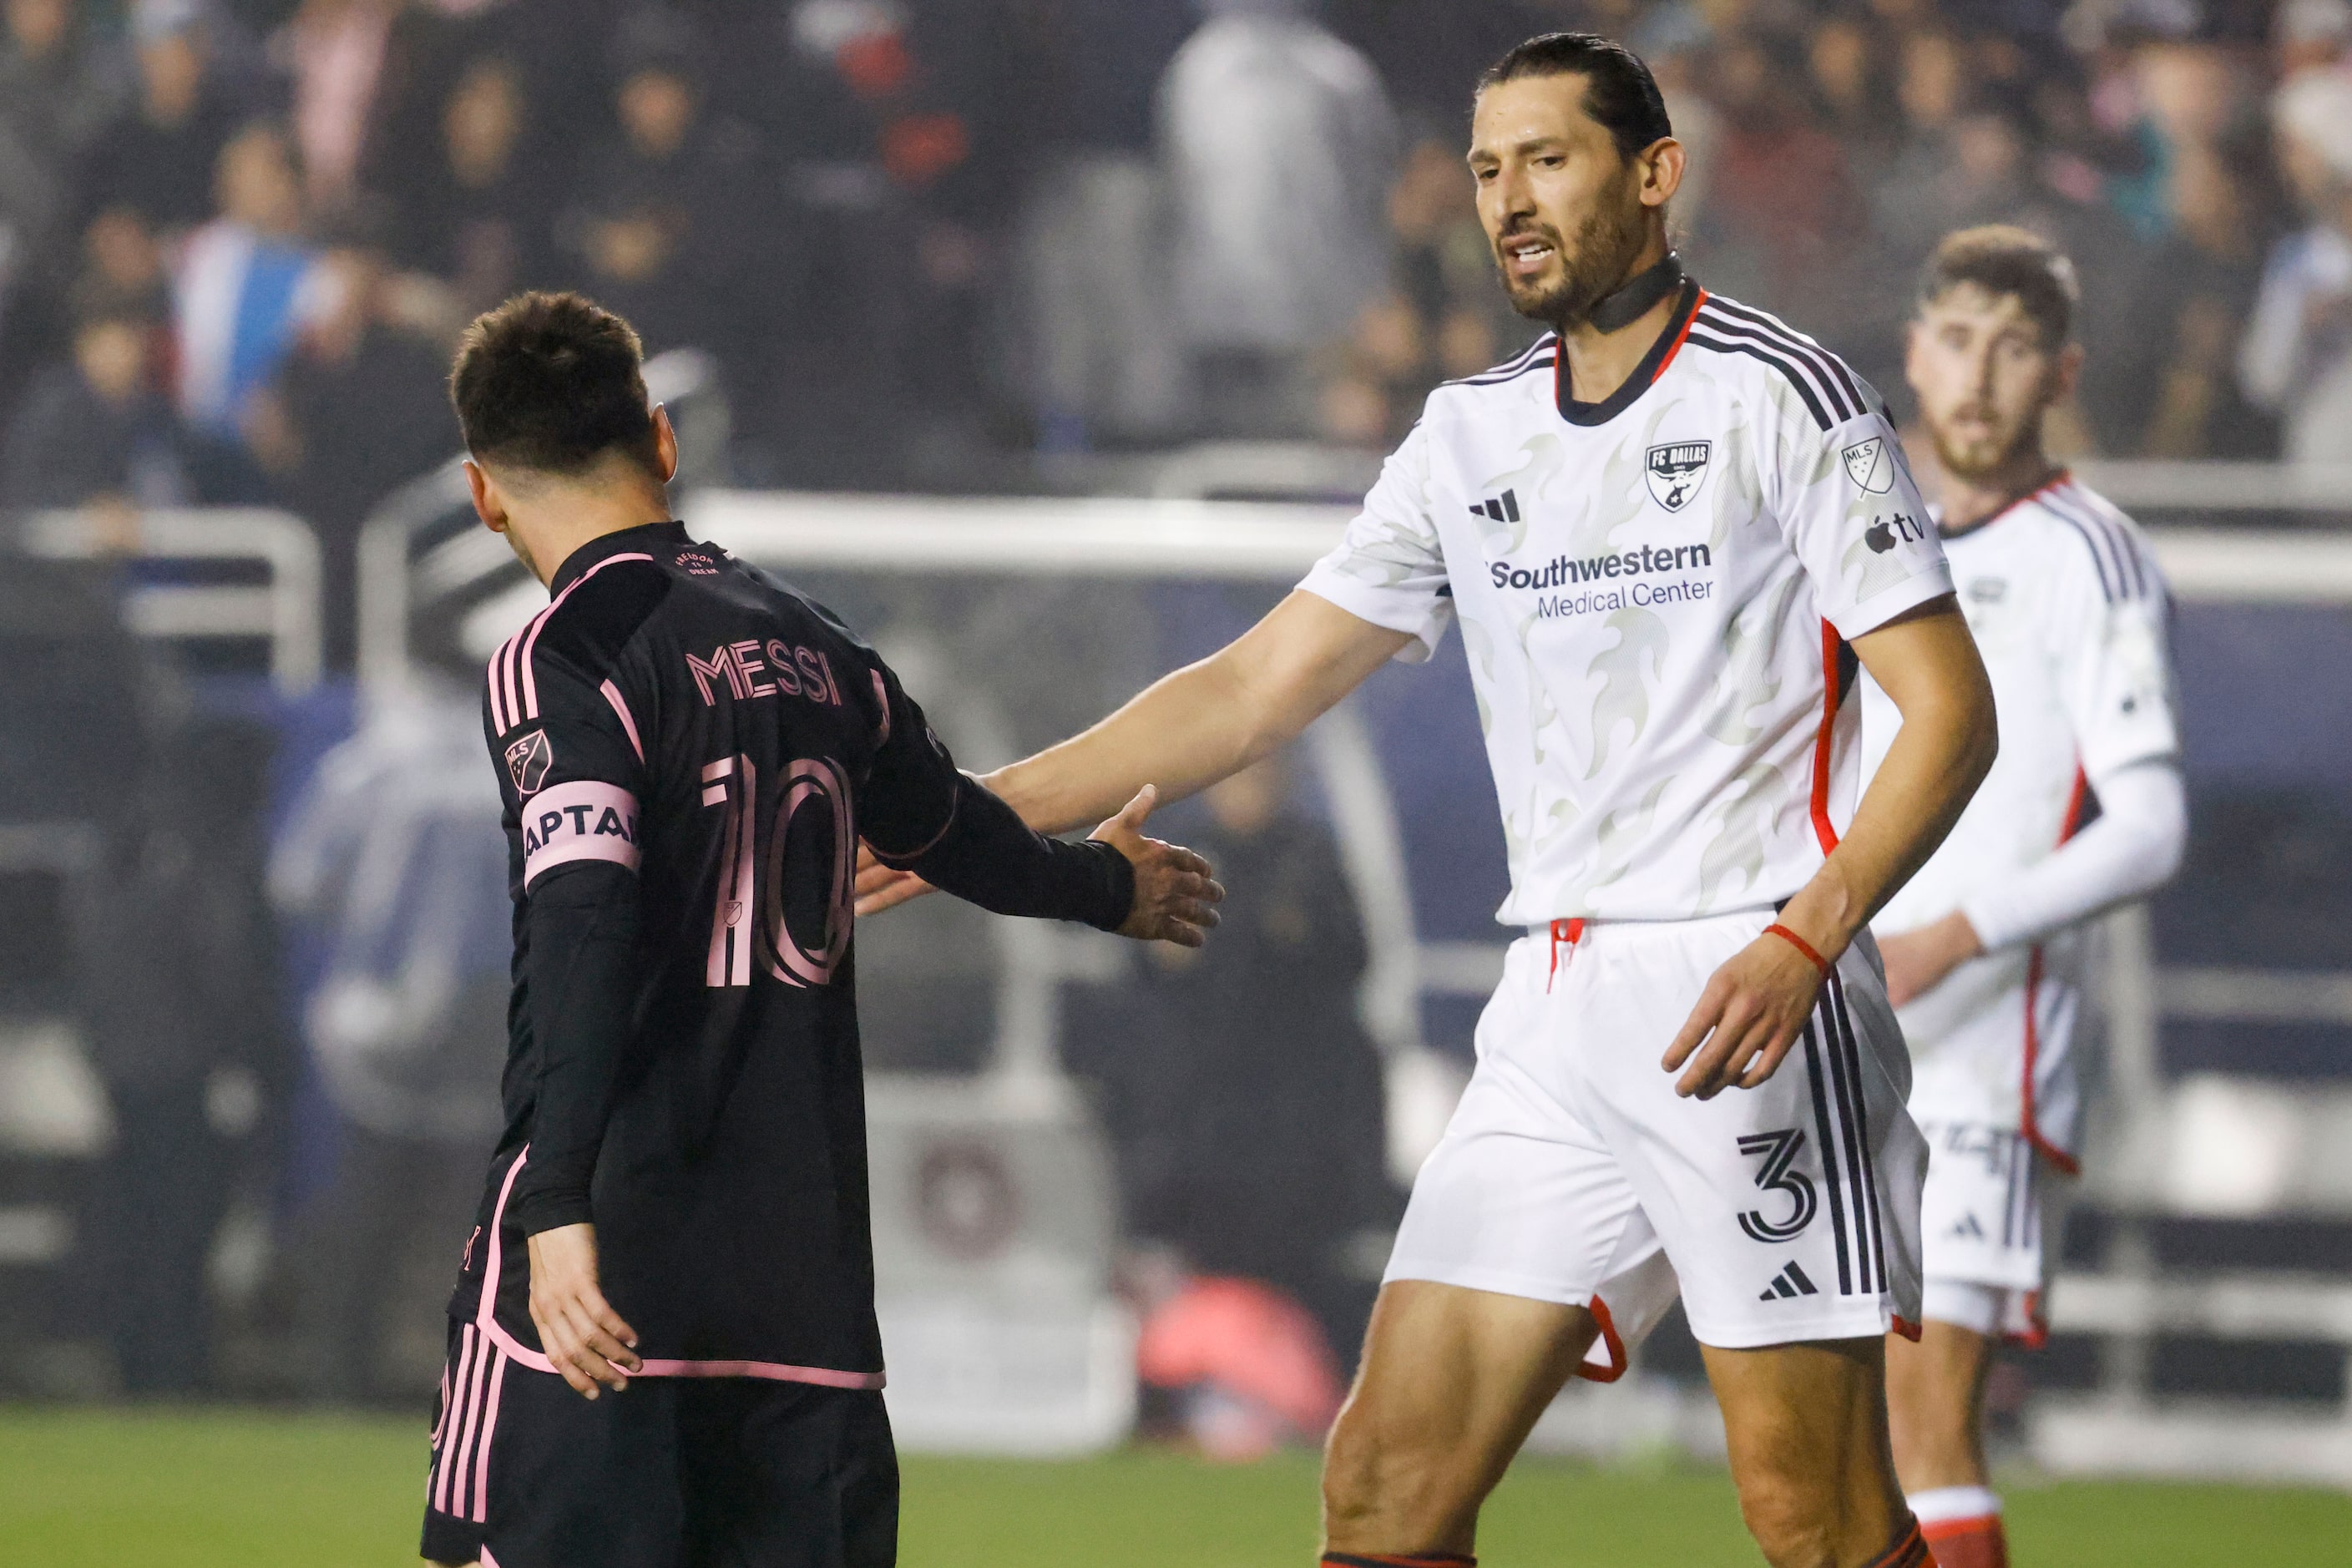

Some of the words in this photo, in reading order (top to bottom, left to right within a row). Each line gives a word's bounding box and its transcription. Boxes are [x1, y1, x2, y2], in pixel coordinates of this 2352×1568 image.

[1652, 450, 1667, 468] FC
[1670, 446, 1707, 464] DALLAS
[1846, 444, 1873, 463] MLS
[1491, 543, 1711, 589] Southwestern
[1538, 586, 1627, 619] Medical
[1632, 579, 1713, 606] Center
[685, 639, 842, 706] MESSI
[508, 742, 529, 766] MLS
[701, 753, 855, 989] 10
[1737, 1128, 1817, 1243] 3
